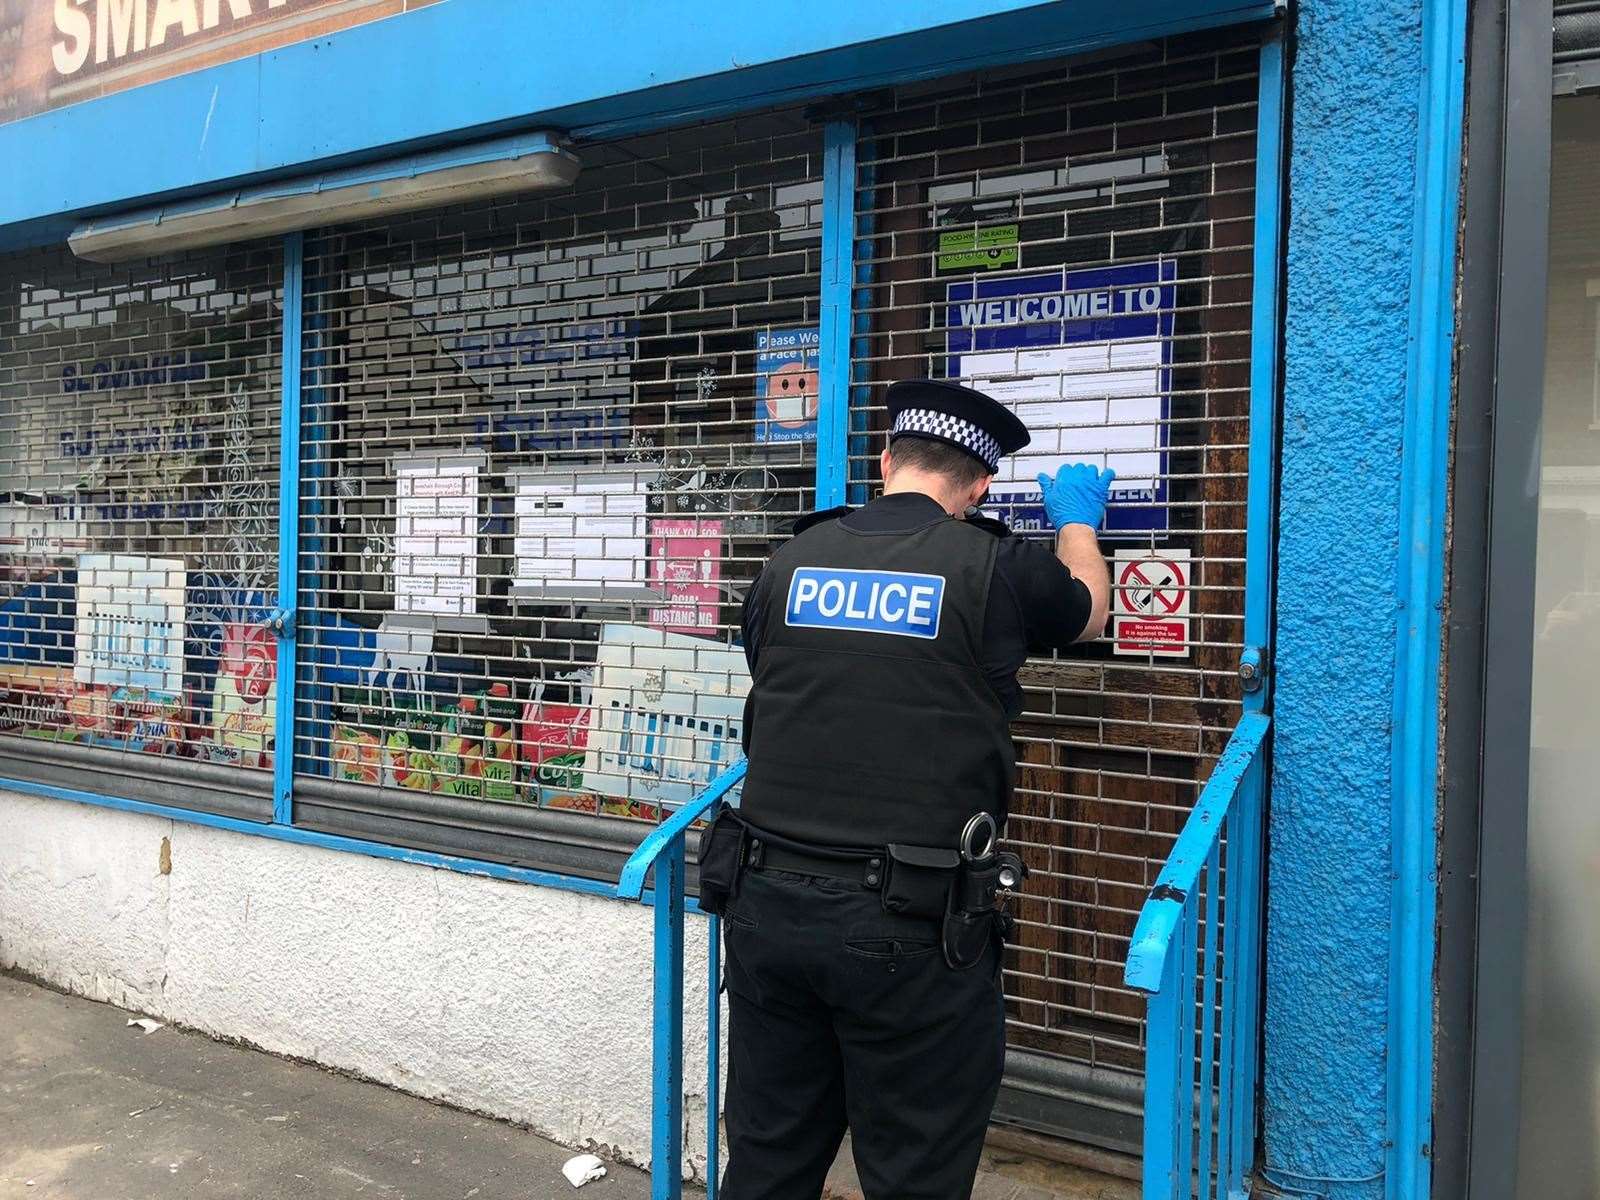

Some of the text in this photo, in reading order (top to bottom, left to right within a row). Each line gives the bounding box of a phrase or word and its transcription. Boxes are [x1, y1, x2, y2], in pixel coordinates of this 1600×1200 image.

[52, 0, 286, 74] SMA
[964, 230, 990, 240] HYGNE
[960, 286, 1161, 327] WELCOME TO
[759, 332, 819, 348] Pease We
[801, 347, 819, 357] as
[774, 433, 790, 441] Stop
[791, 432, 802, 440] the
[804, 431, 818, 442] Spr
[1003, 514, 1041, 531] 8am
[669, 594, 699, 608] OCIAL
[794, 578, 935, 626] POLICE
[653, 609, 712, 625] DISTANCNG
[484, 767, 511, 780] vita
[453, 781, 480, 797] vita
